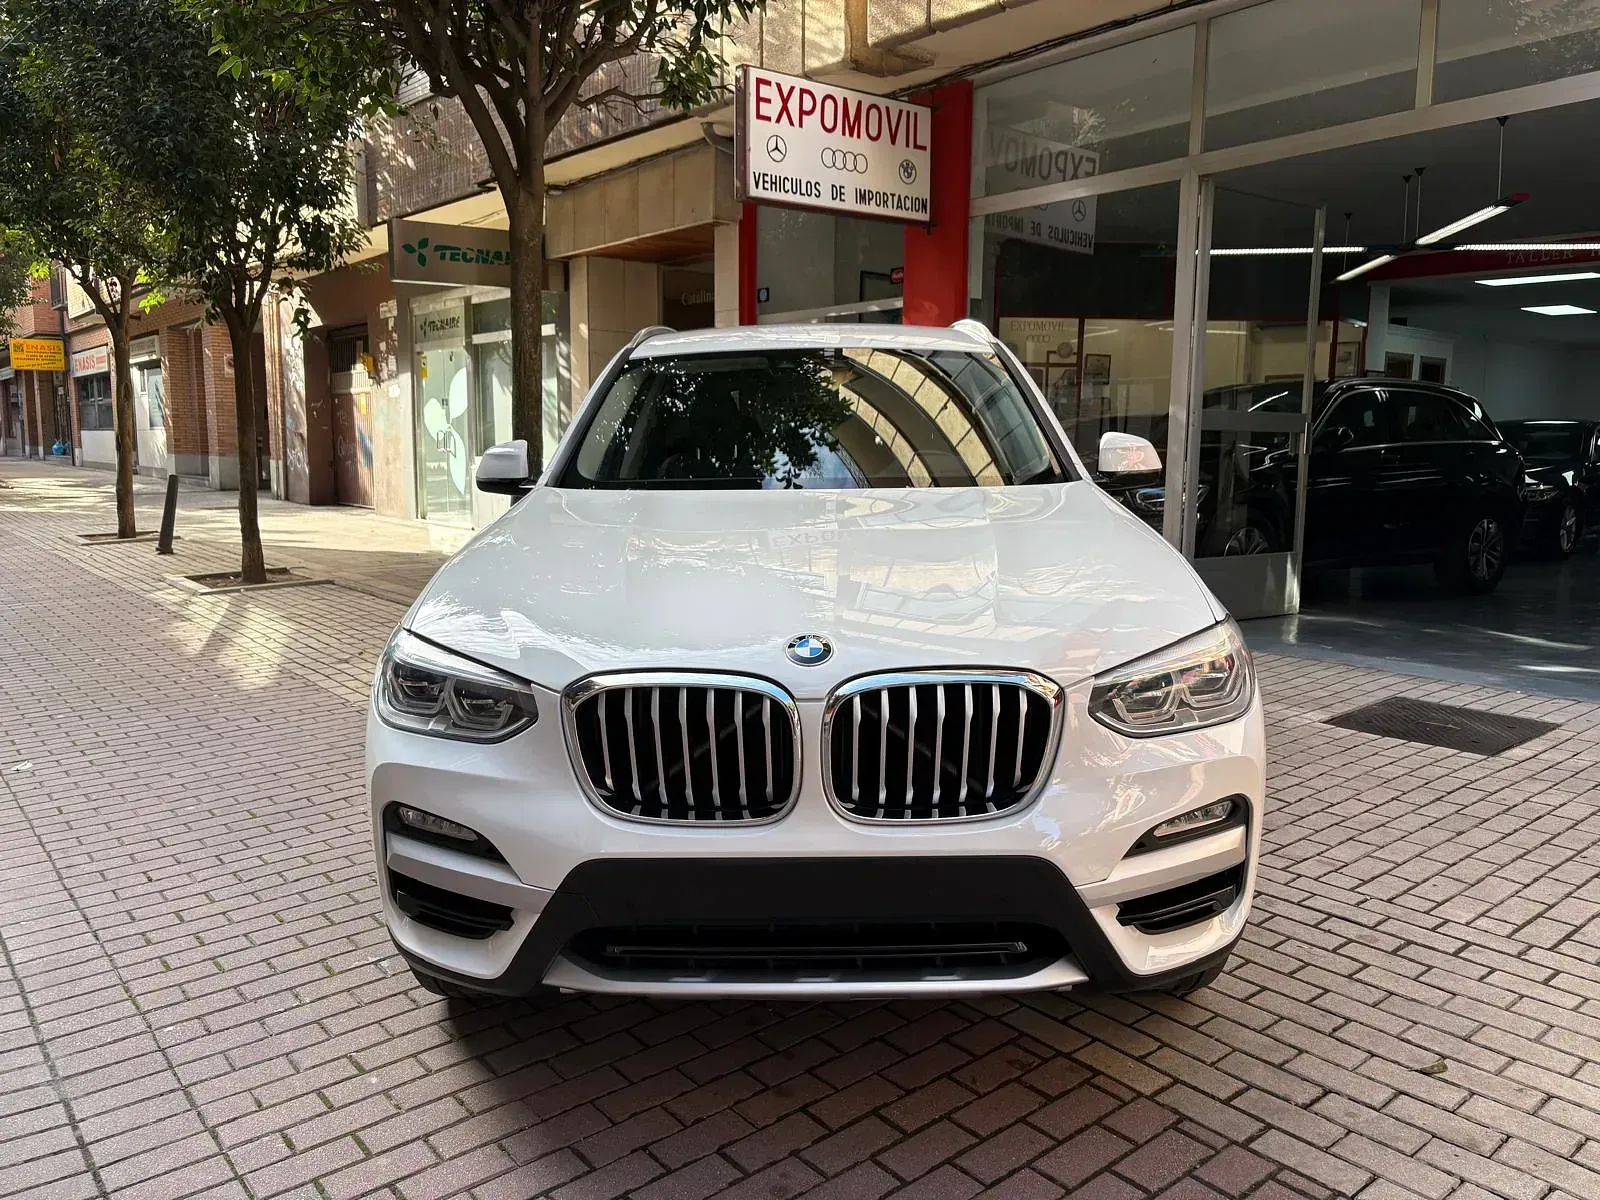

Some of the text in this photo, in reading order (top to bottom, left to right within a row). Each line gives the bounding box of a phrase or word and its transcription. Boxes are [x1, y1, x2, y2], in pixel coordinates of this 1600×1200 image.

[755, 77, 927, 151] EXPOMOVIL
[753, 171, 928, 214] VEHICULOS DE IMPORTACION
[428, 316, 461, 333] TECNAIRE
[74, 355, 96, 373] ENASIS
